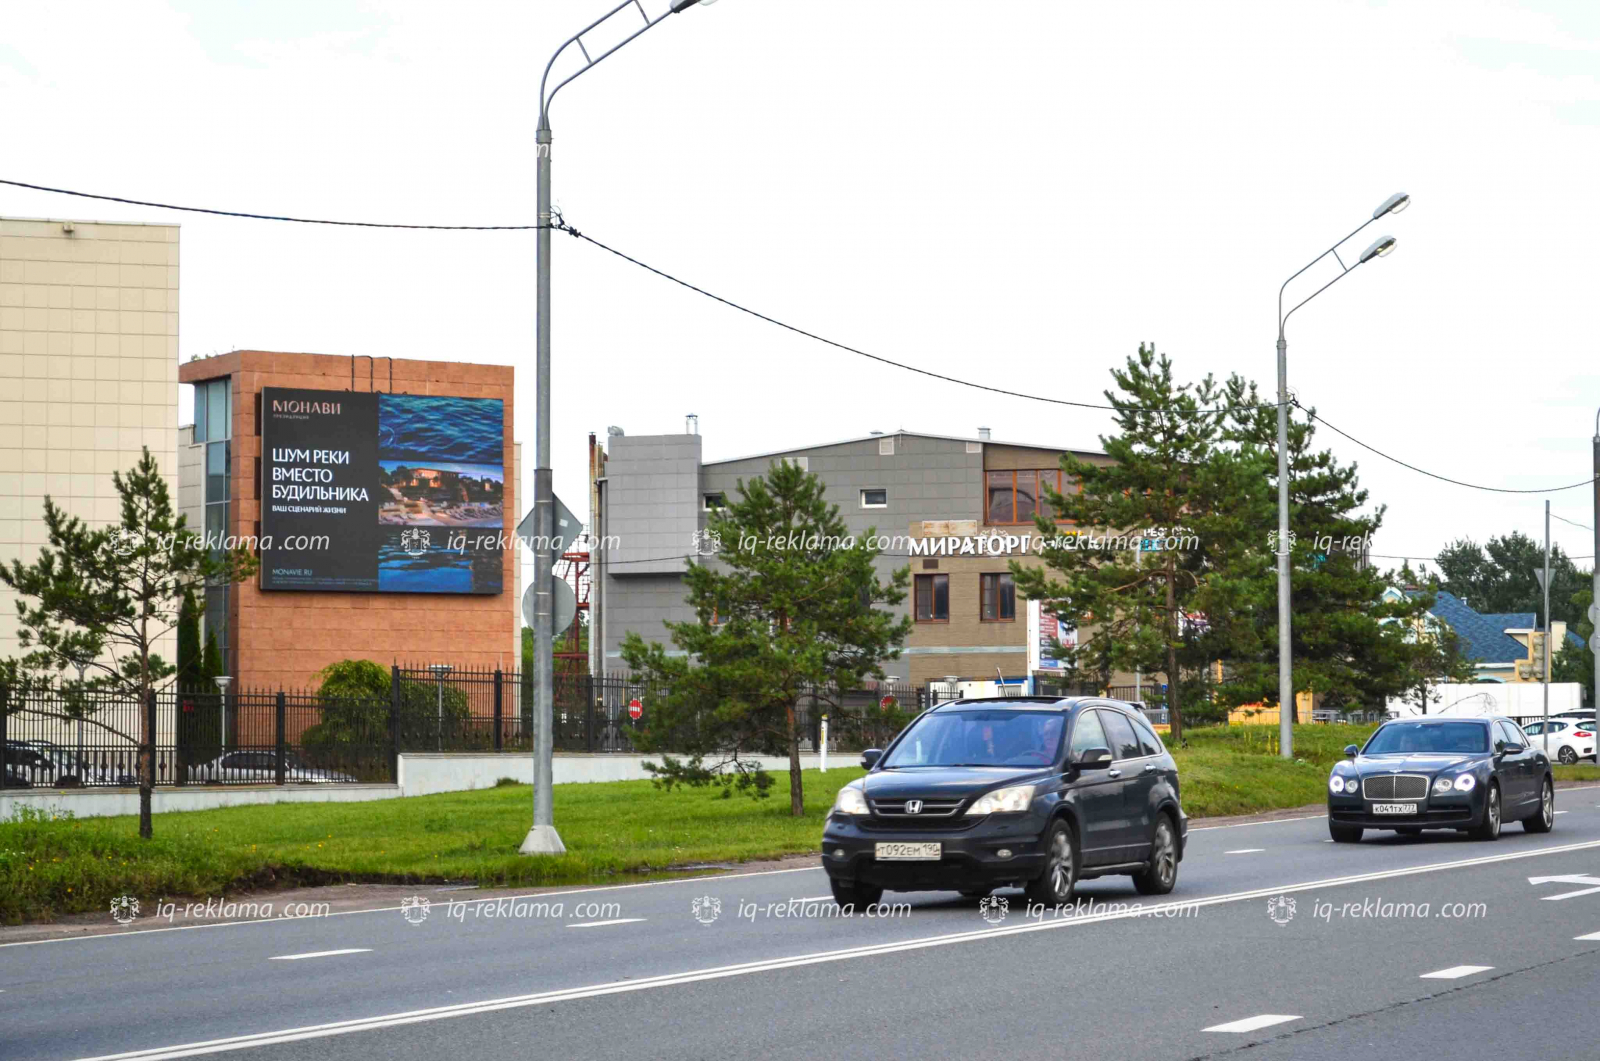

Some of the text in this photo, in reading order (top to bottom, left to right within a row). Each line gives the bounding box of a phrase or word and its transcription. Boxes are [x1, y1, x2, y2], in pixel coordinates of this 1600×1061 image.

[273, 400, 341, 415] МОНАВИ
[273, 448, 349, 465] ШУМ РЕКИ
[273, 467, 333, 483] ВМЕСТО
[272, 485, 369, 502] БУДИЛЬНИКА
[288, 506, 322, 514] СЦЕНАРИЙ
[908, 535, 1031, 556] МИРАТОРГ
